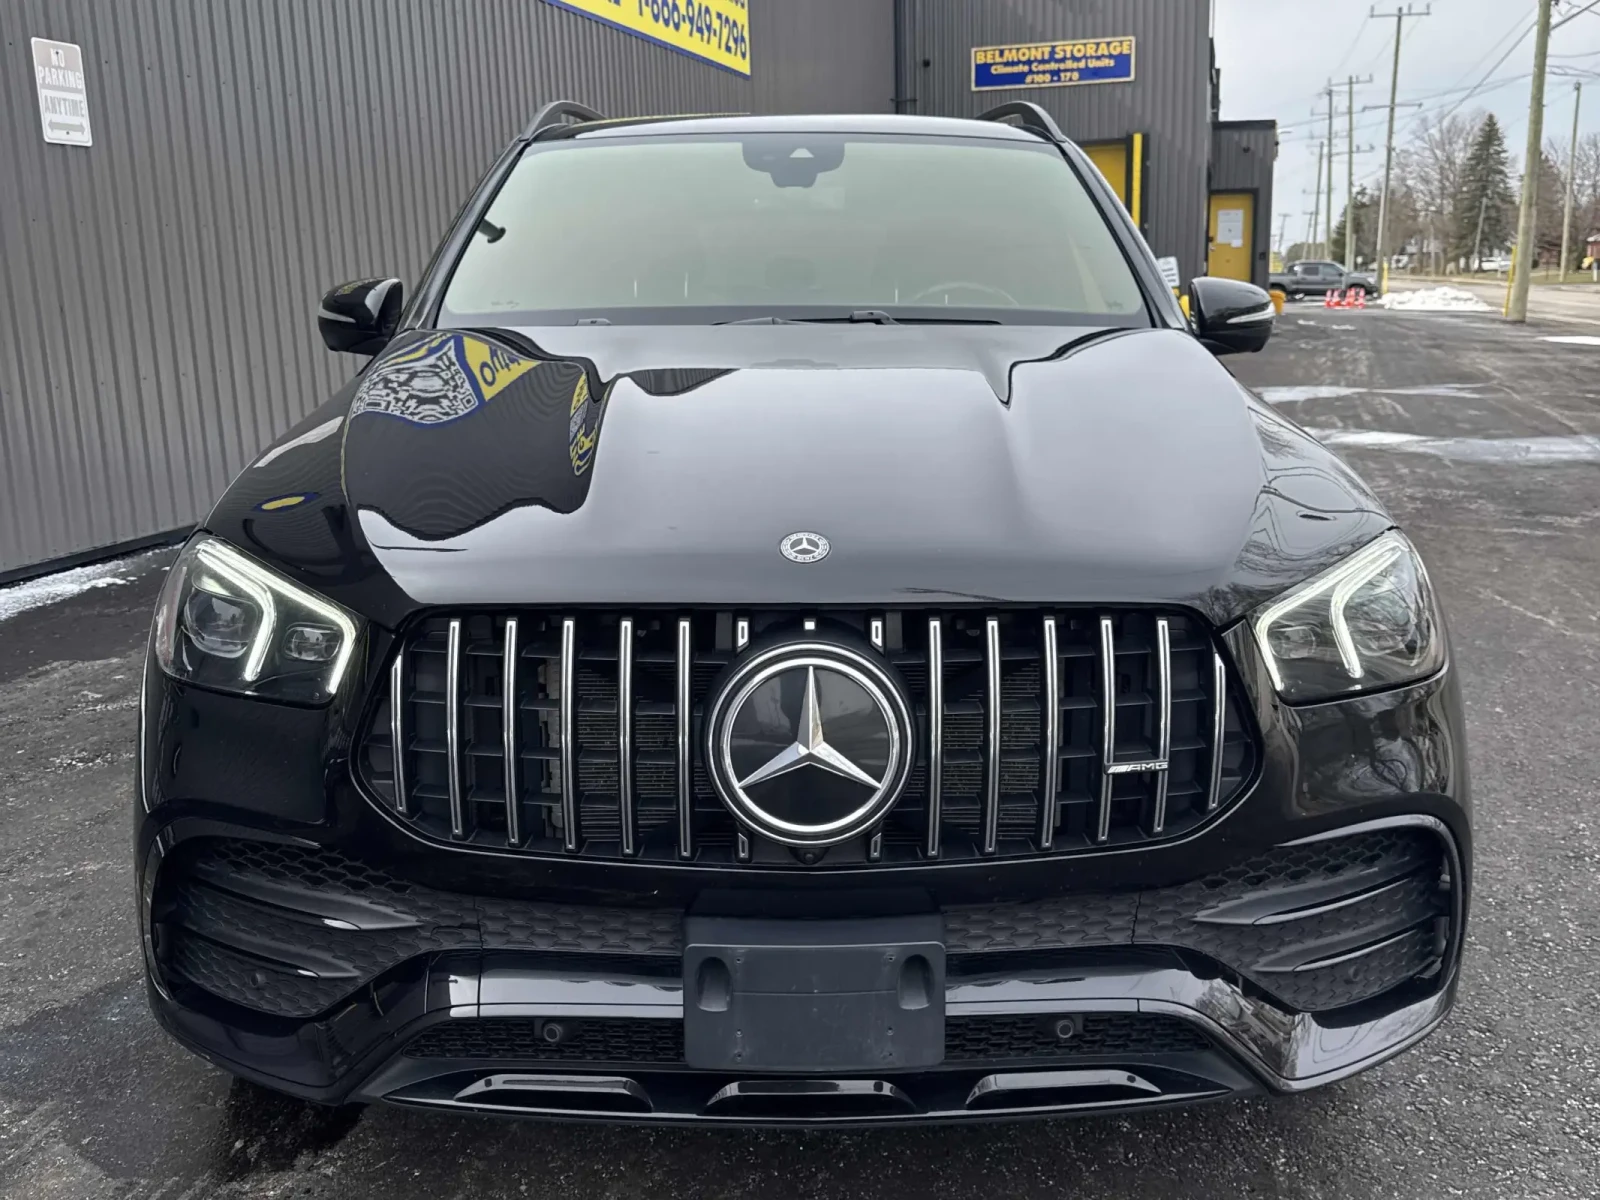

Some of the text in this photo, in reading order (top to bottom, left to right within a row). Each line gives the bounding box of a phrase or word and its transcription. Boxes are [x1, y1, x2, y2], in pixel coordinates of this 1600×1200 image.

[50, 48, 65, 67] NO
[976, 42, 1131, 64] BELMONT STORAGE
[38, 66, 82, 88] PARKING
[991, 58, 1114, 74] Climate Controlled Units
[45, 94, 84, 117] ANYTIME
